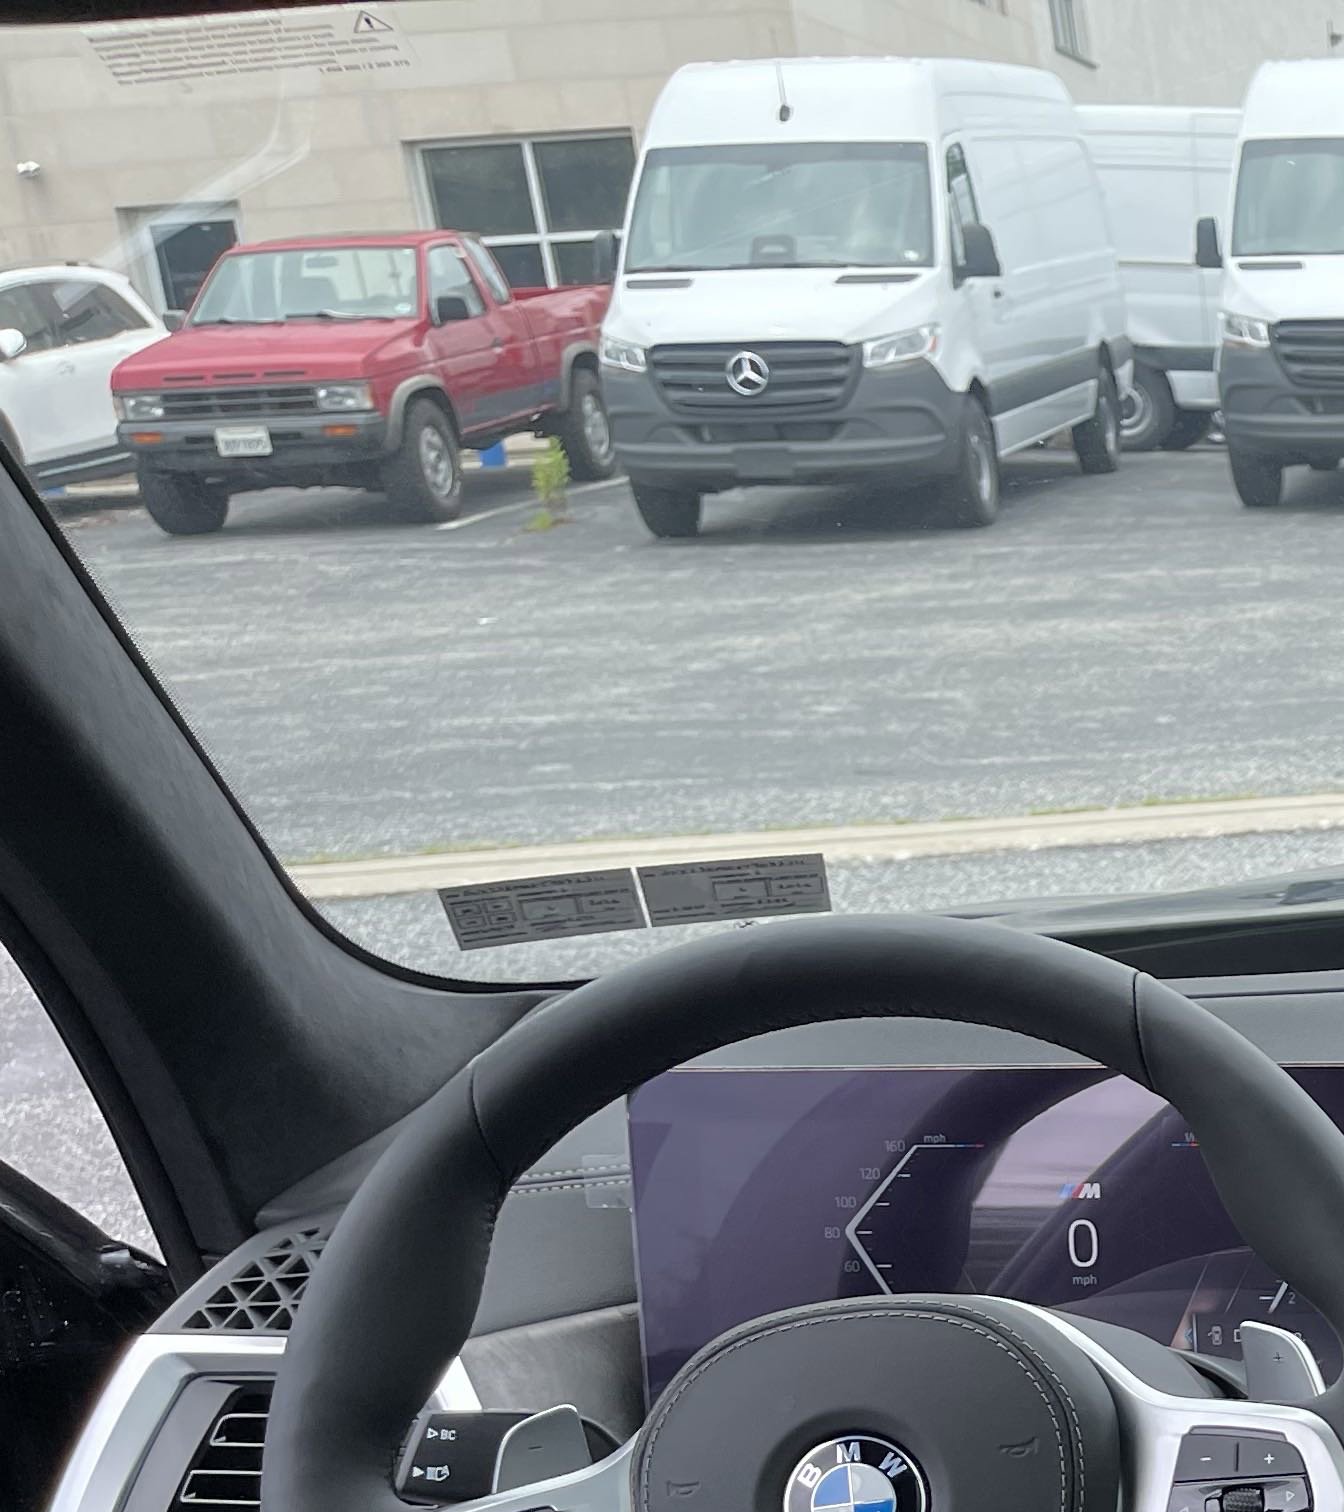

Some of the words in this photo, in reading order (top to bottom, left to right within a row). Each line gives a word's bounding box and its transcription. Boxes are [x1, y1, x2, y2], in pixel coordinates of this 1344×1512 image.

[923, 1134, 946, 1144] mph
[884, 1140, 906, 1152] 160
[859, 1168, 880, 1180] 120
[835, 1197, 857, 1208] 100
[824, 1227, 840, 1239] 80
[1068, 1219, 1098, 1268] 0
[844, 1261, 860, 1273] 60
[1072, 1275, 1097, 1287] mph
[1288, 1291, 1296, 1304] 2
[797, 1441, 907, 1489] BMW
